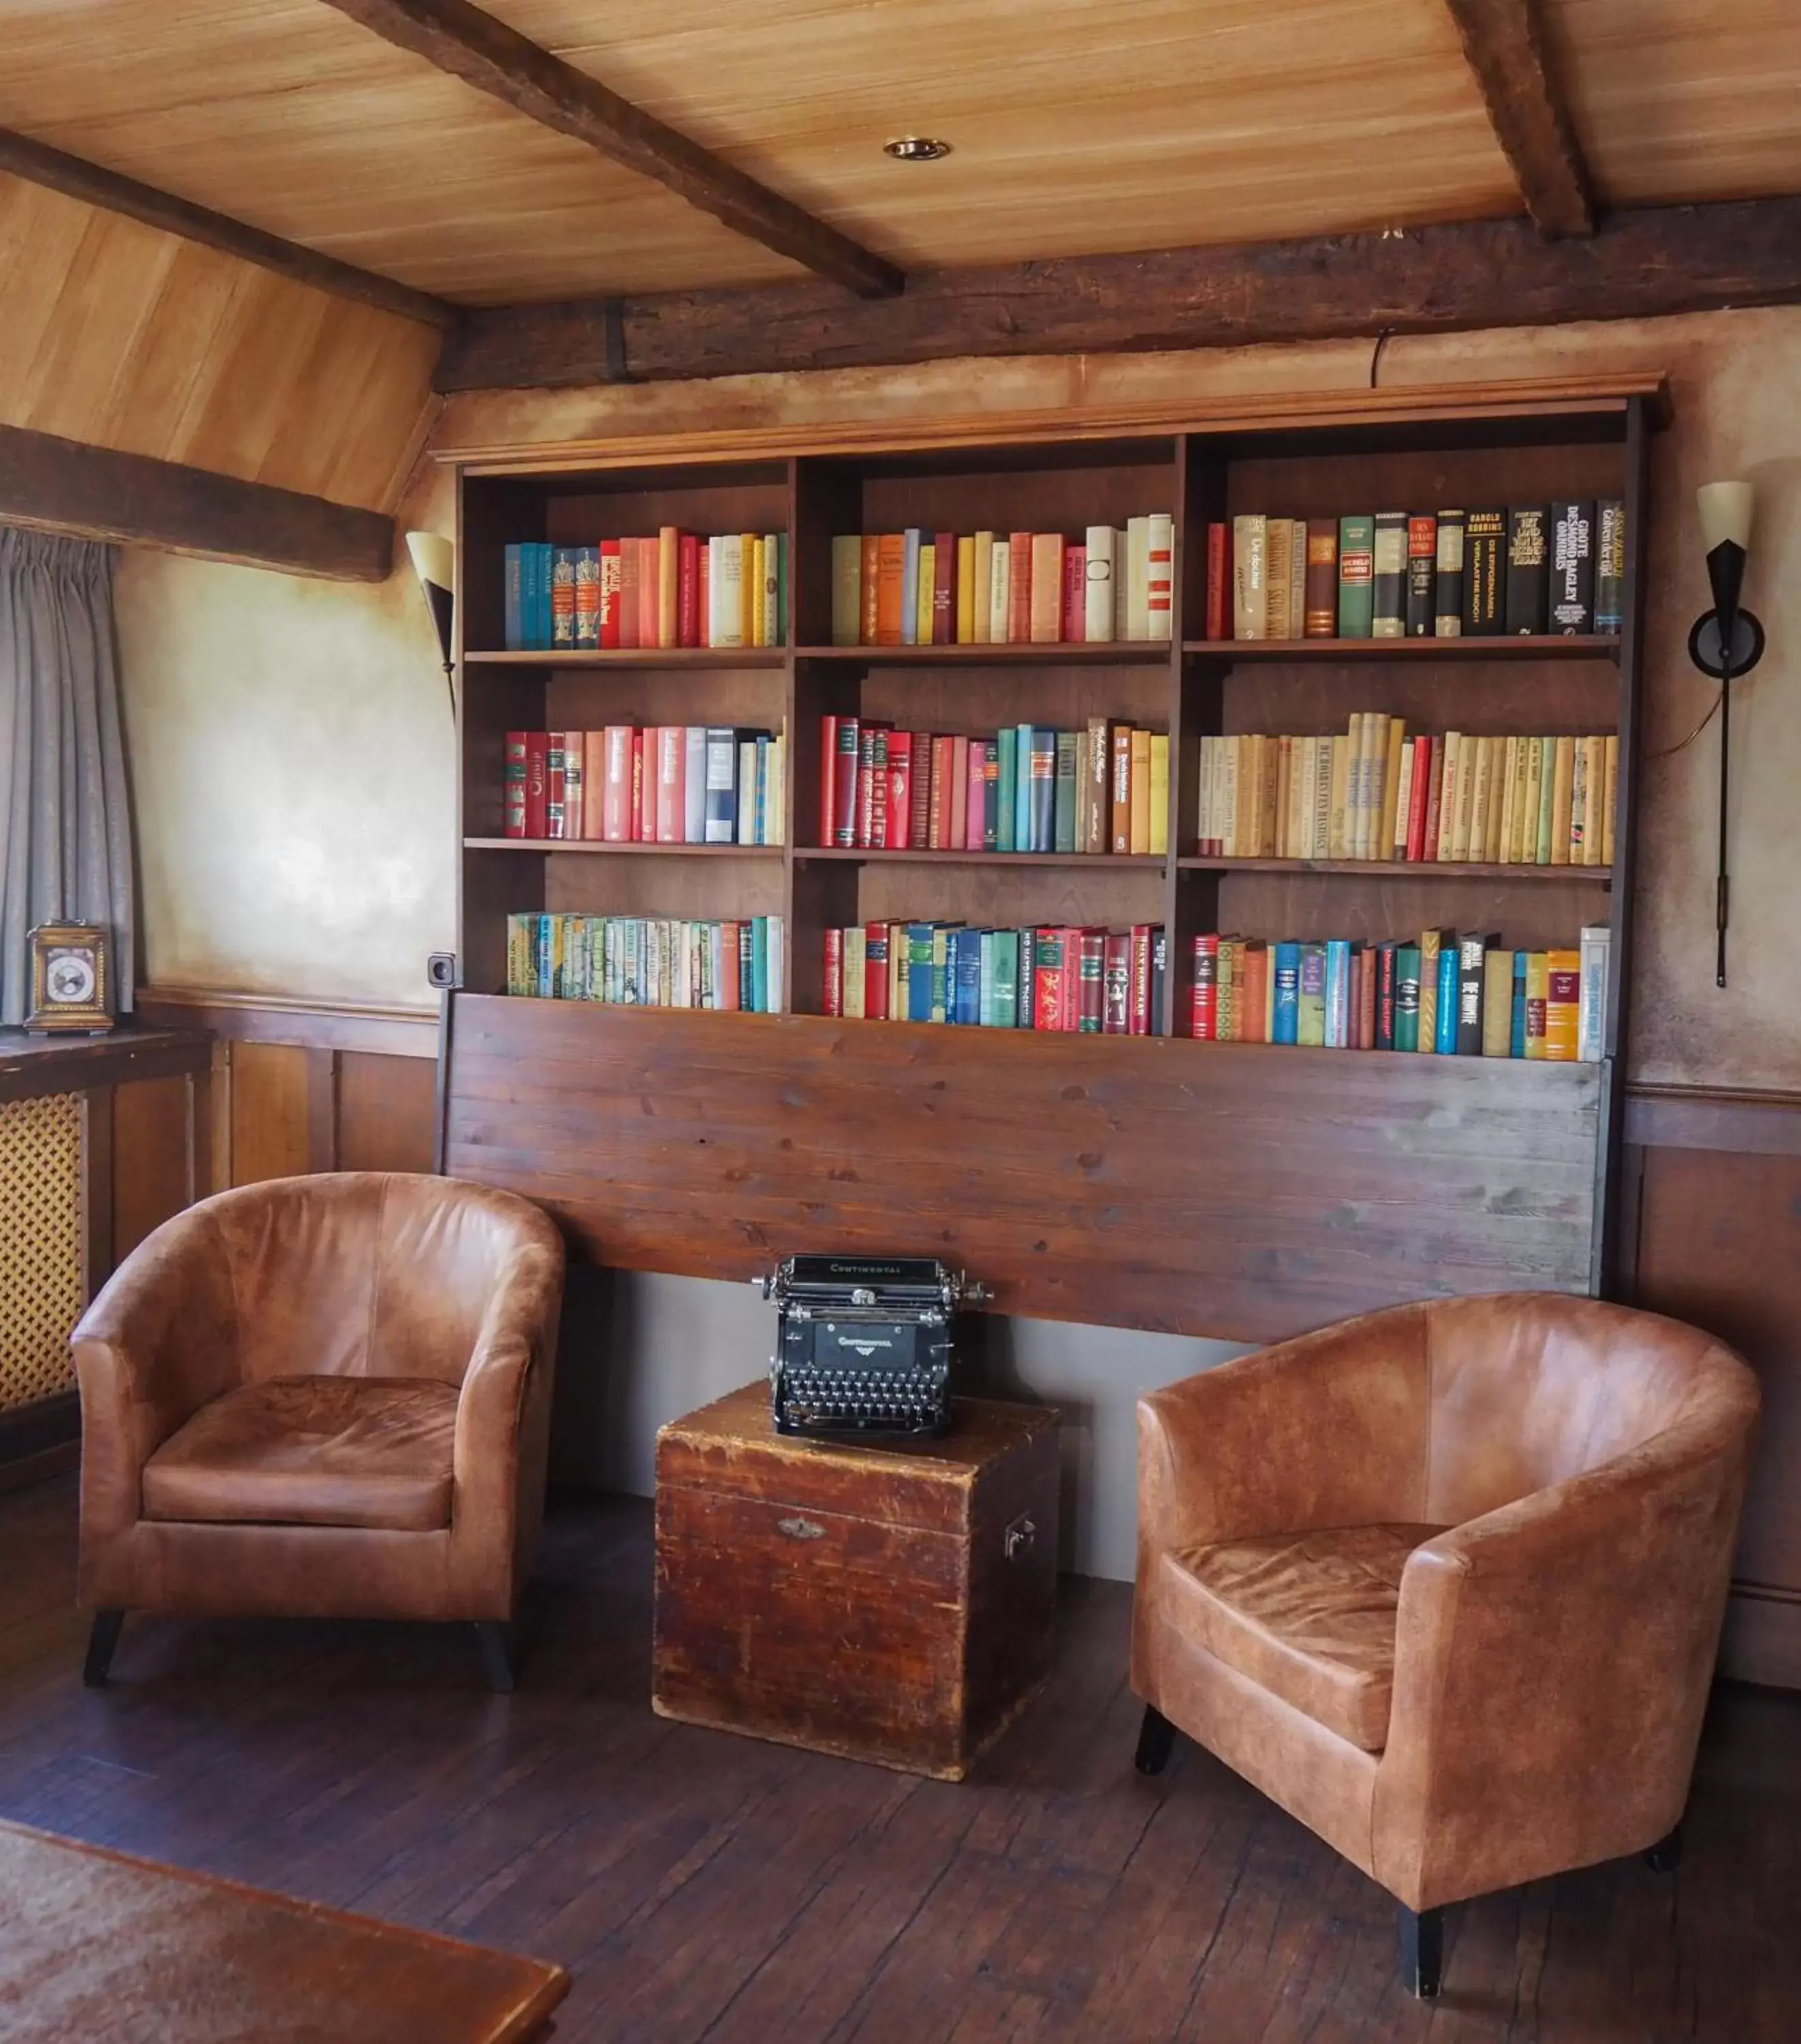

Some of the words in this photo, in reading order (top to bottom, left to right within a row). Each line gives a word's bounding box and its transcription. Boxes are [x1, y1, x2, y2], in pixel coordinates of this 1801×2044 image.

[1251, 539, 1263, 553] De
[1556, 521, 1567, 570] OMNIBUS
[1567, 506, 1578, 558] DESMOND
[1577, 520, 1588, 557] GROTE
[1250, 555, 1262, 589] dochter
[1473, 540, 1482, 578] VERLAAT
[1565, 559, 1578, 601] BAGLEY
[1462, 982, 1479, 993] DE
